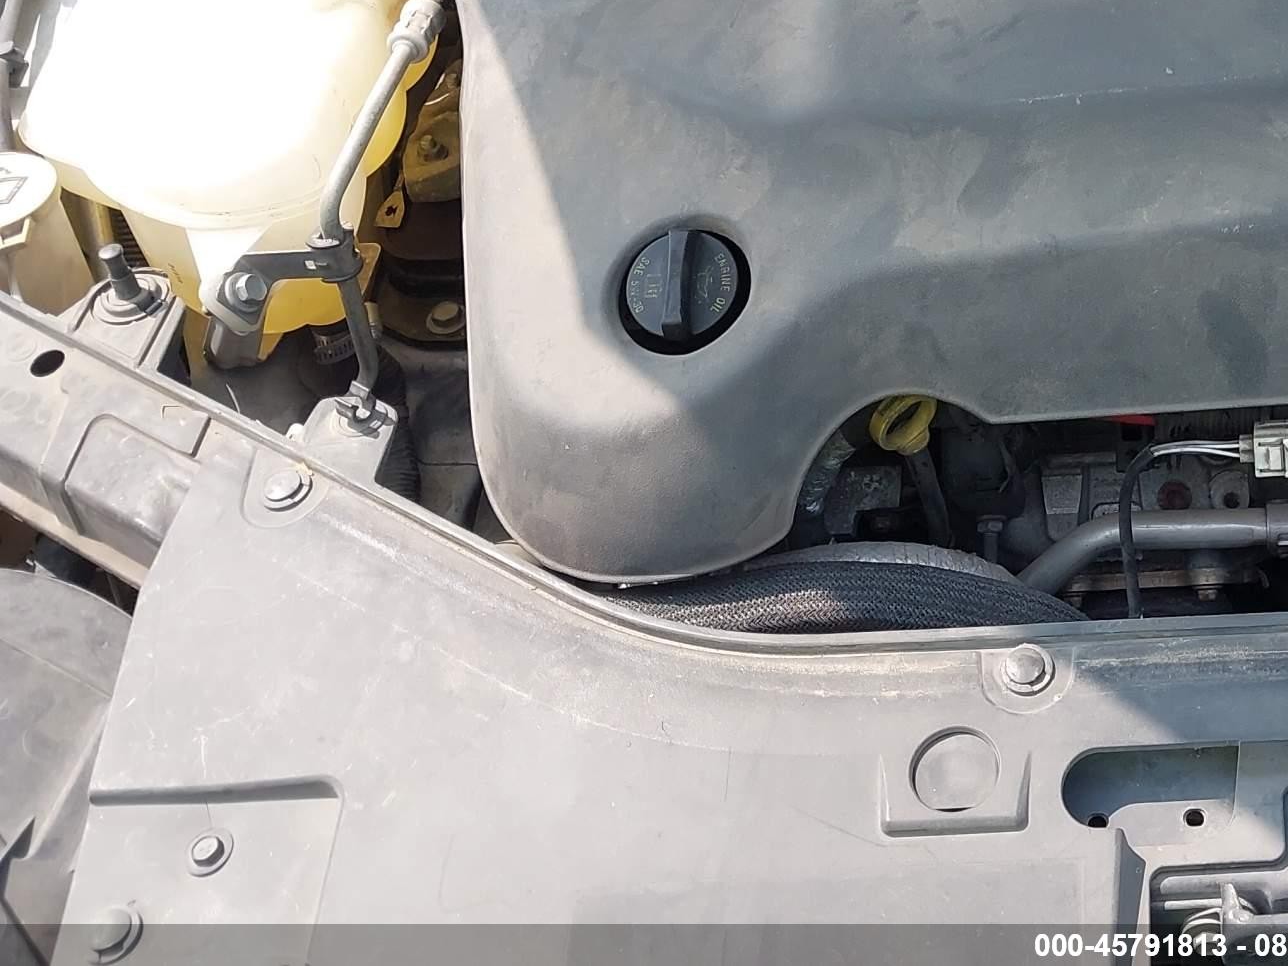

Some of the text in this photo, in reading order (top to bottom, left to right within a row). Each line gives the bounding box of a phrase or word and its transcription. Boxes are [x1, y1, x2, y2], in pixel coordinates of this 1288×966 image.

[633, 256, 650, 275] SAE
[710, 253, 731, 313] ENGINE OIL
